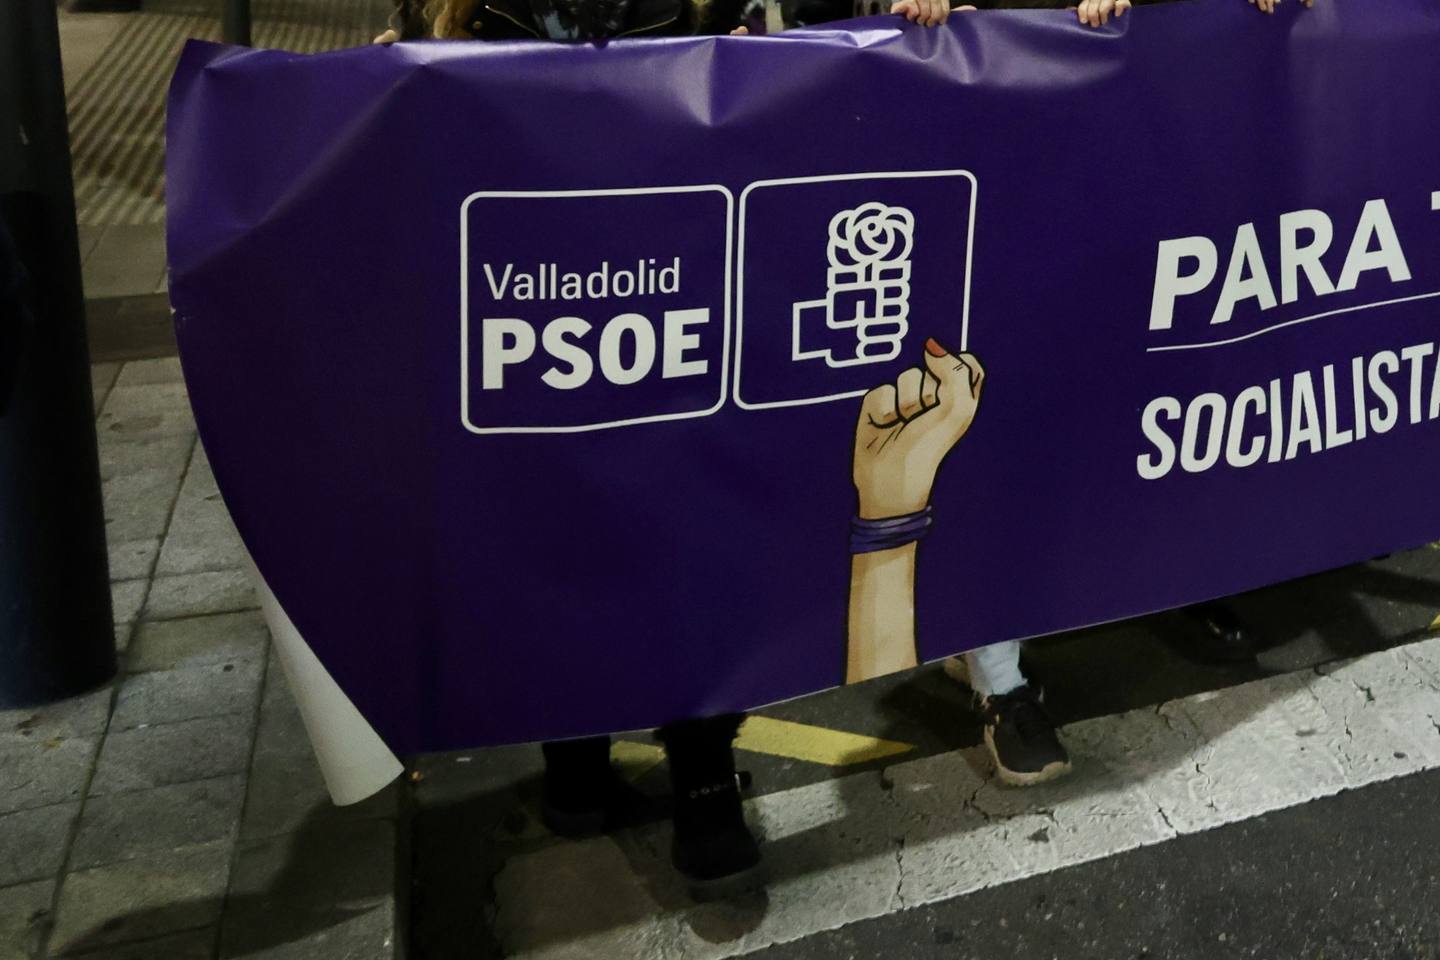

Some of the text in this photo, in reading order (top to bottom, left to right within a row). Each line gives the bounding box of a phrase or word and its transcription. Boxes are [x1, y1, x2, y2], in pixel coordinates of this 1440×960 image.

[483, 257, 680, 301] Valladolid
[1148, 198, 1412, 331] PARA
[482, 308, 710, 390] PSOE
